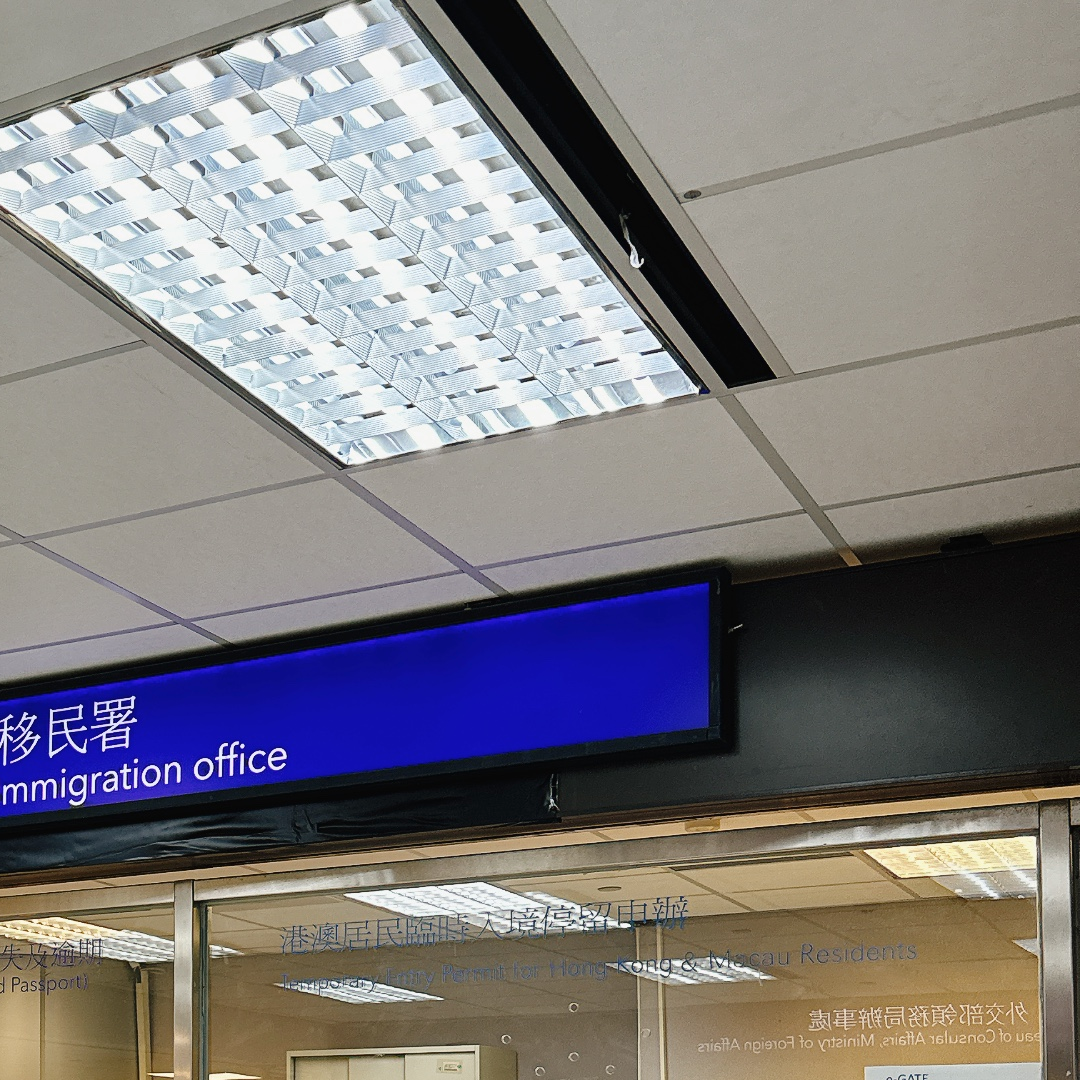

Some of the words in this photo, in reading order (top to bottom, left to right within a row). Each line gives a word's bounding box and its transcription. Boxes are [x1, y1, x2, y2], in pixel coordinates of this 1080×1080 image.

[193, 740, 288, 780] office
[281, 896, 689, 955] 港澳居民臨時入境停留申辦
[12, 973, 89, 996] Passport)
[281, 973, 379, 994] Temporary
[386, 967, 435, 991] Entry
[442, 963, 504, 984] Permit
[514, 961, 539, 980] for
[550, 960, 607, 981] Hong
[618, 954, 672, 978] Kong
[681, 951, 698, 972] &
[708, 949, 790, 970] Macau
[801, 940, 918, 964] Residents
